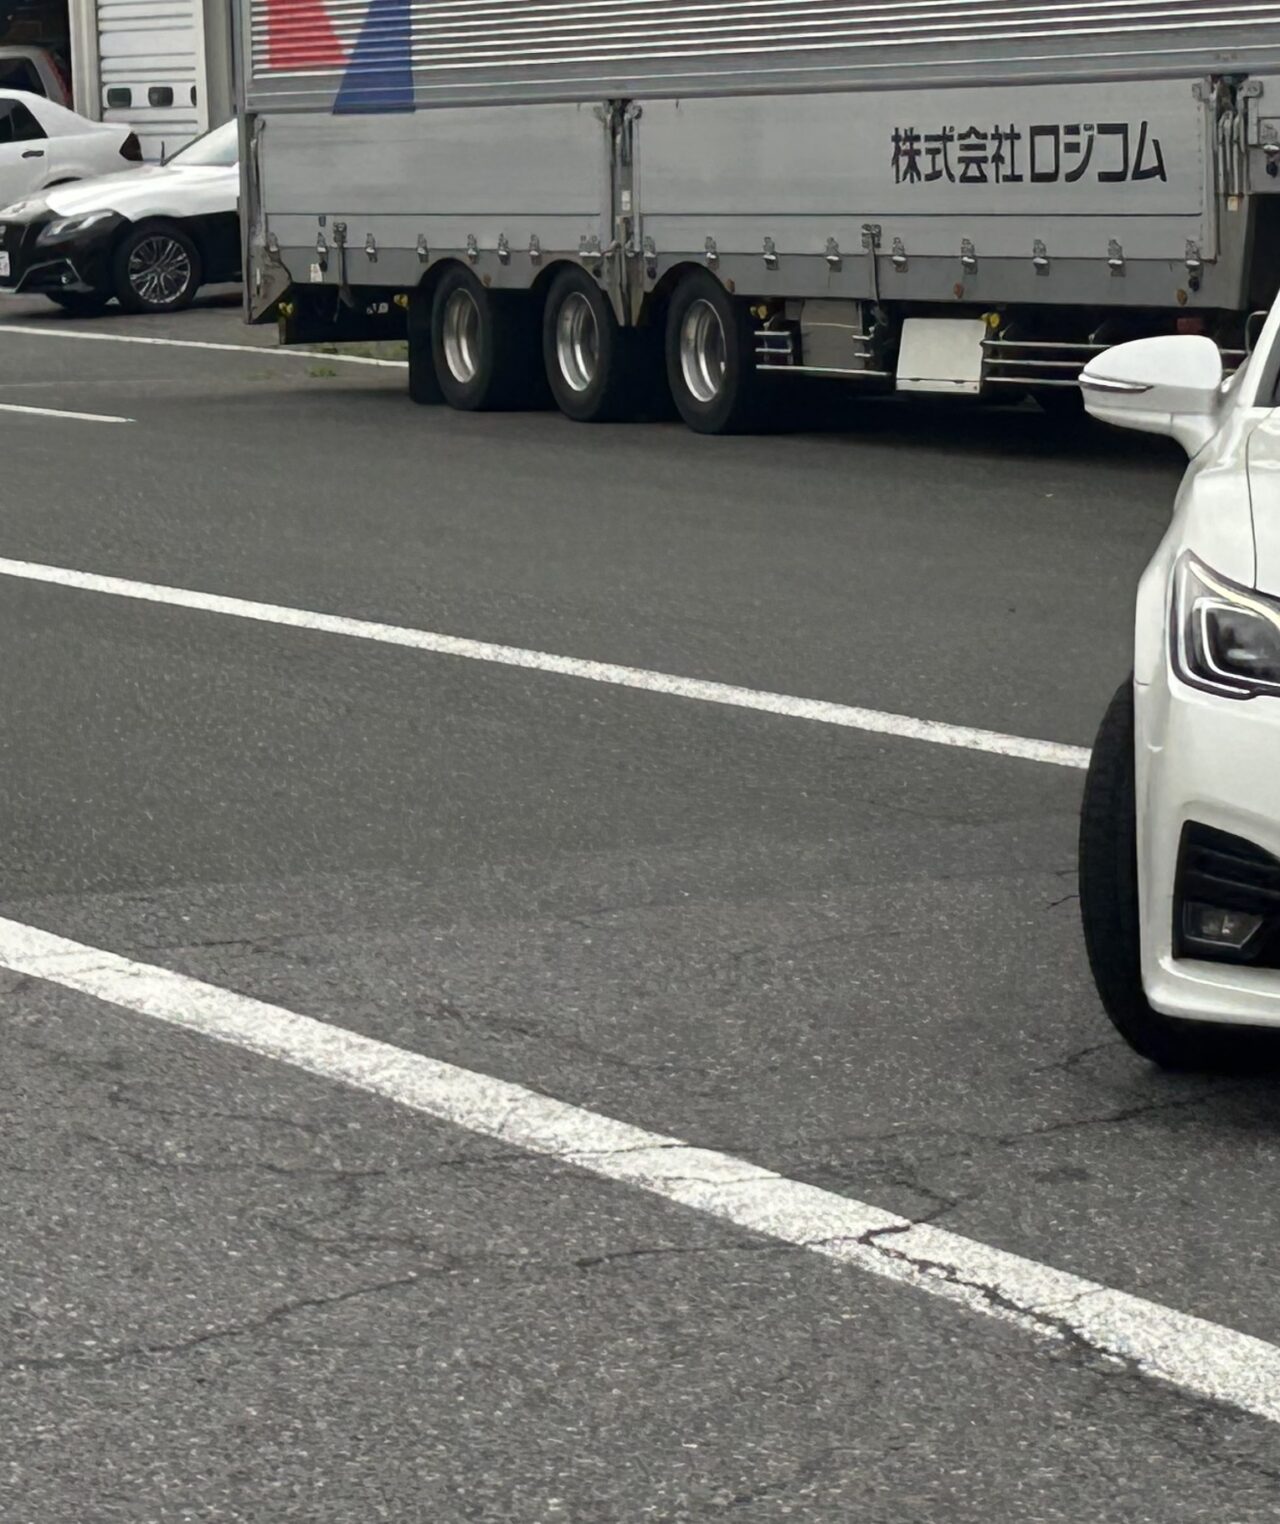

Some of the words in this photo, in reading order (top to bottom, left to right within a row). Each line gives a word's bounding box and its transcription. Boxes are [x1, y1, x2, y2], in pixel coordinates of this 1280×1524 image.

[891, 121, 1167, 184] 株式会社ロジコム
